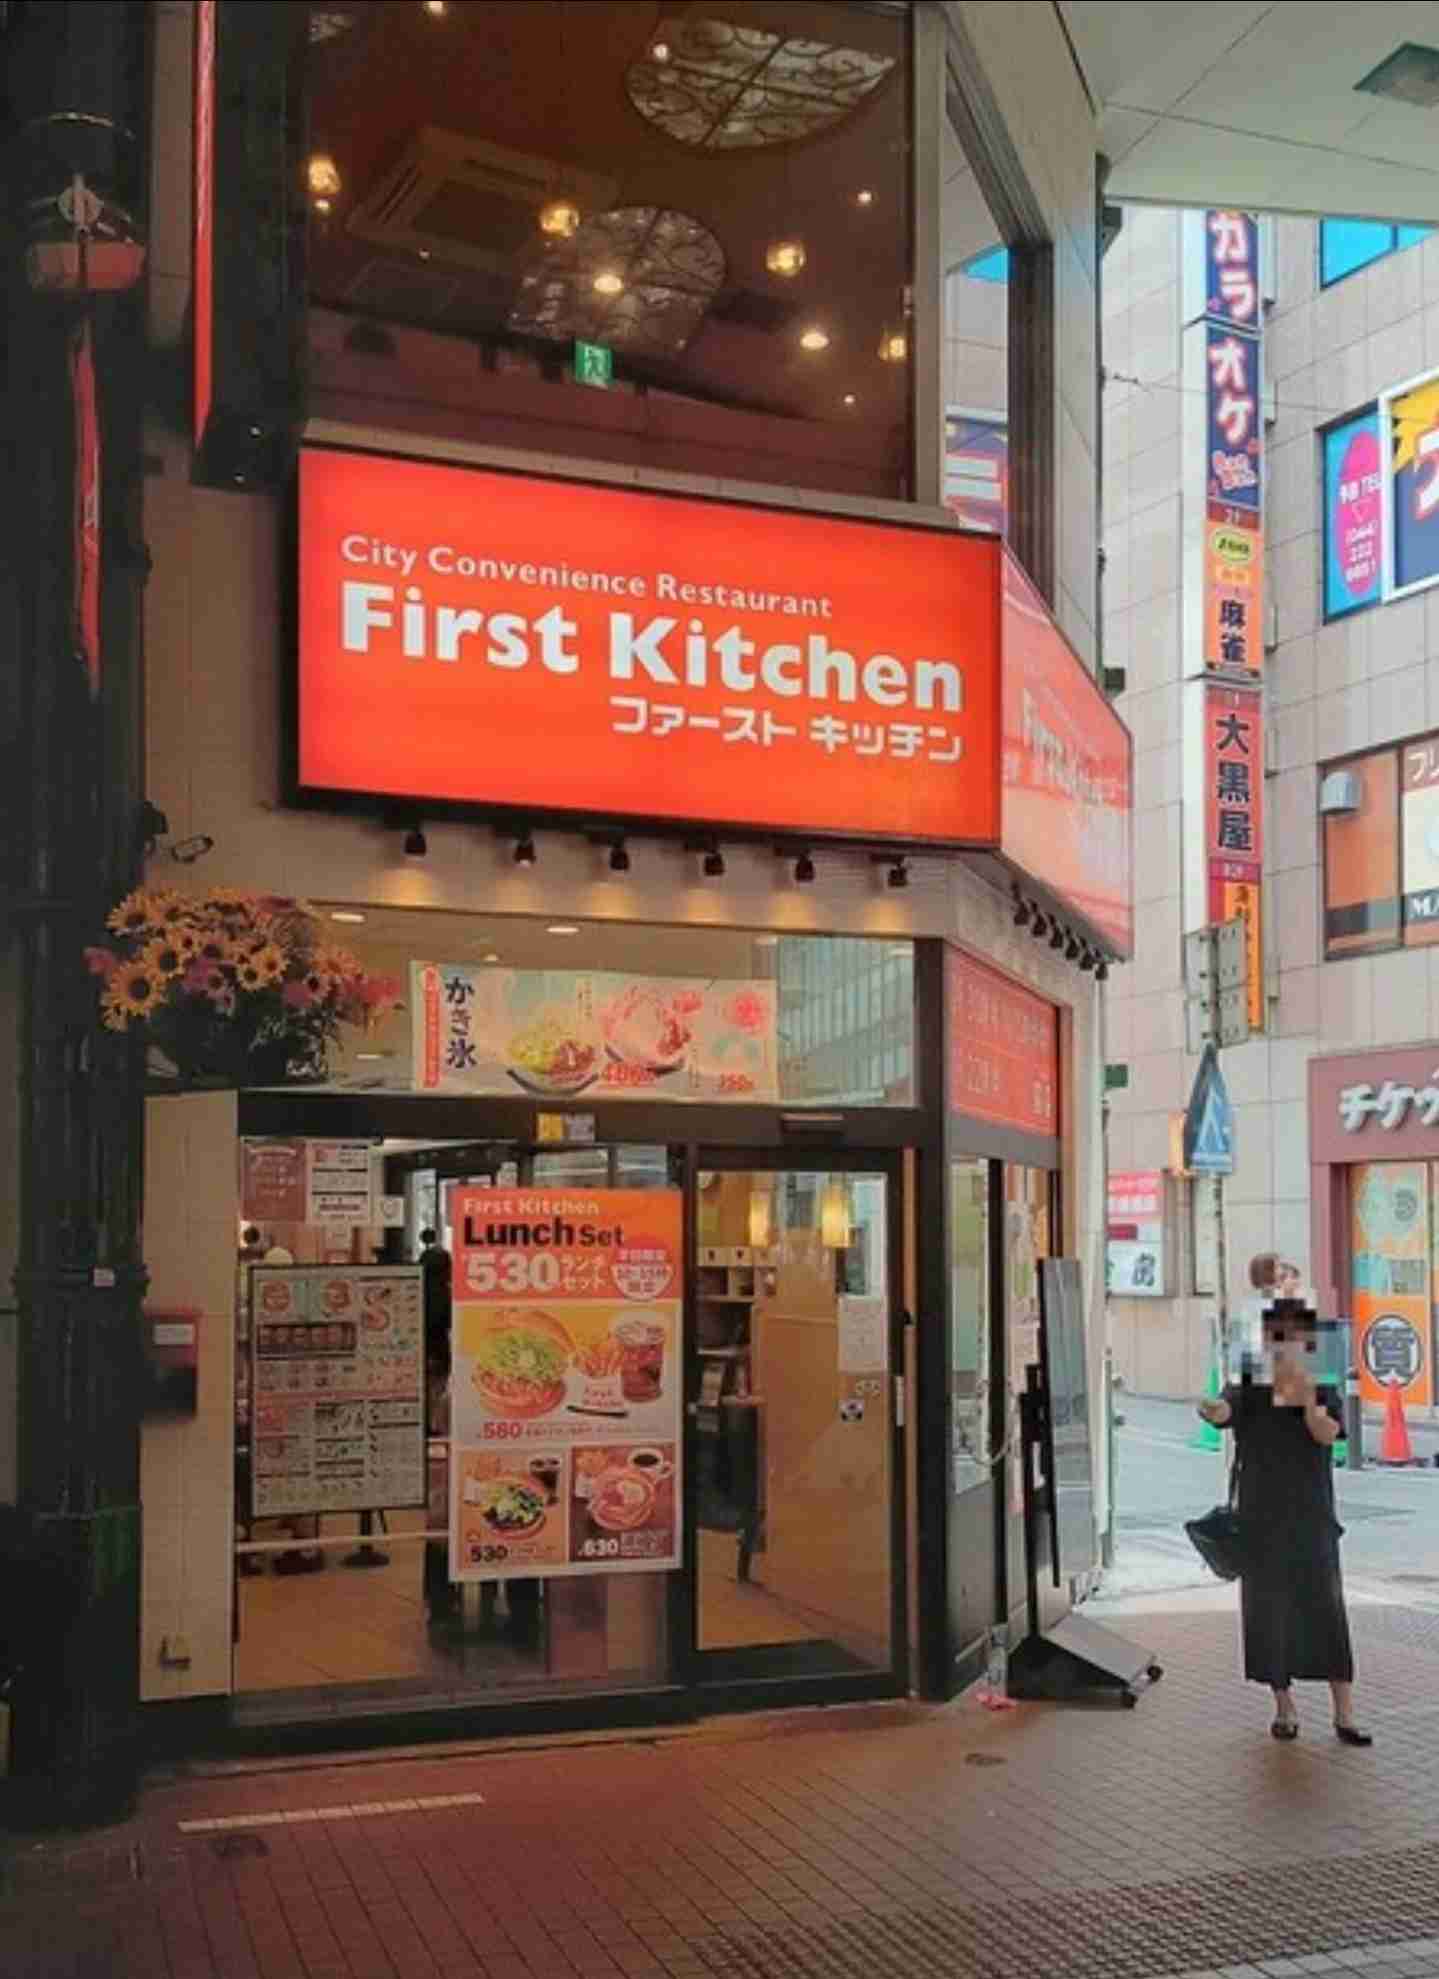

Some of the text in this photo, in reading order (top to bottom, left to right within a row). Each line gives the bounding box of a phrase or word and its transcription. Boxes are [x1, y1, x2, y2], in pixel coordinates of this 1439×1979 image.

[340, 534, 833, 619] City Convenience Restaurant
[340, 580, 964, 712] First Kitchen
[609, 695, 799, 747] ファースト
[809, 715, 964, 764] キッチン
[1215, 713, 1252, 850] 大黒屋
[445, 976, 477, 1069] かき氷
[463, 1217, 574, 1247] Lunch
[466, 1251, 561, 1293] 530
